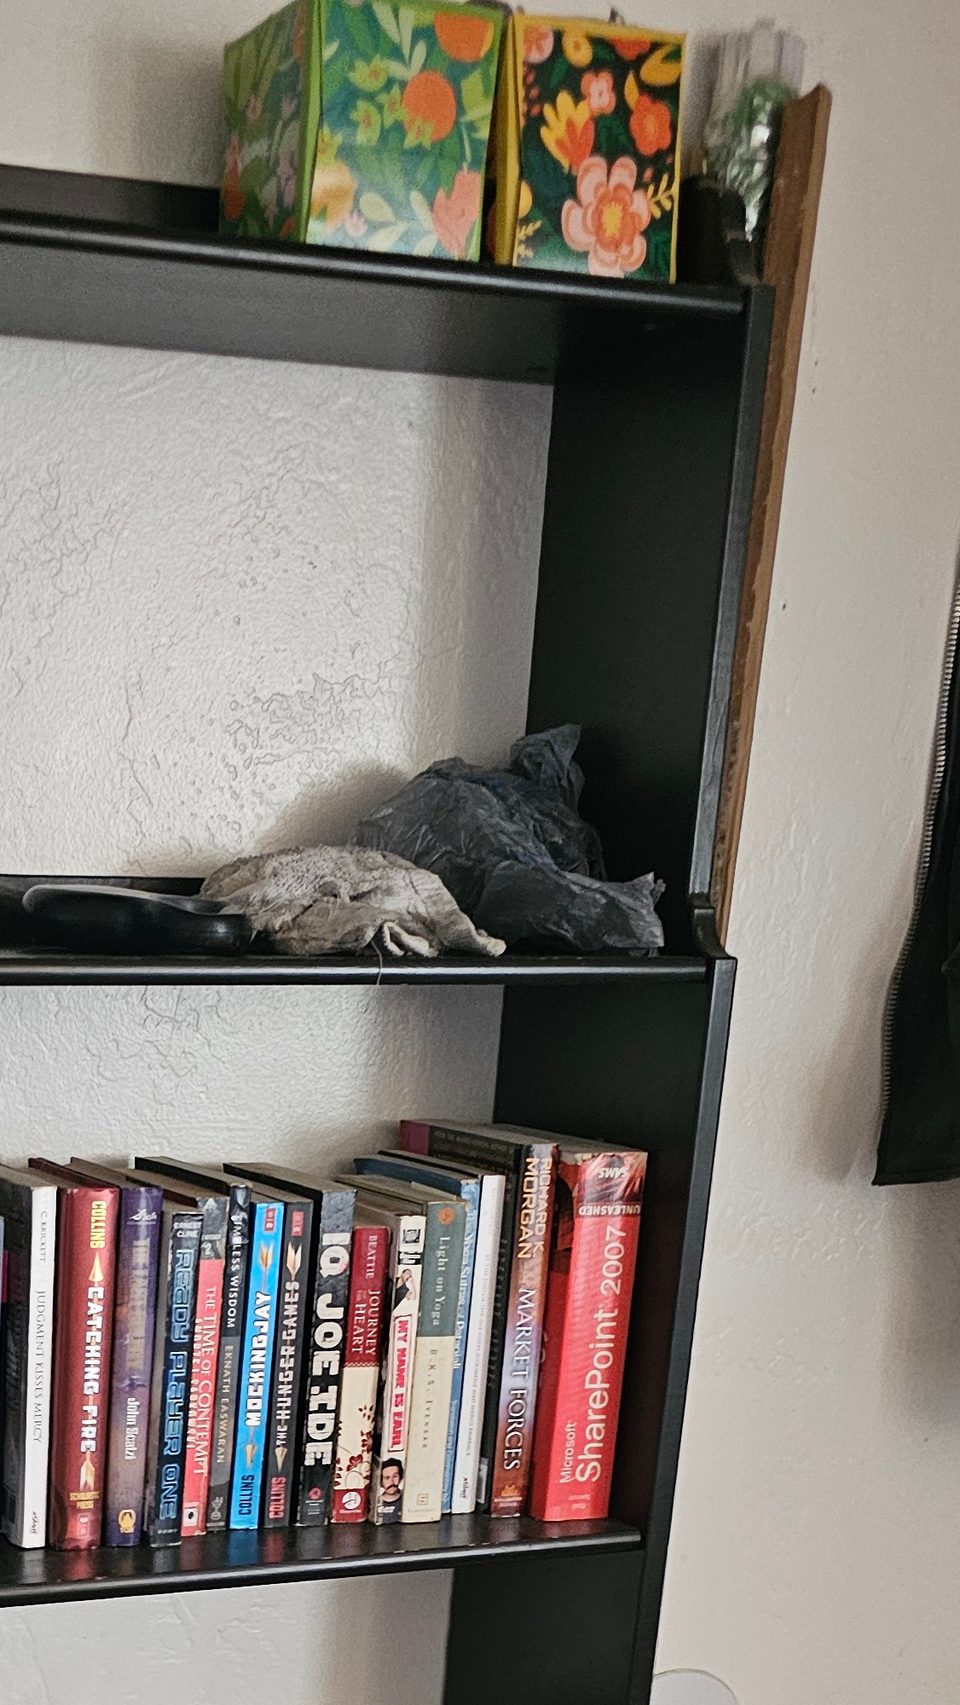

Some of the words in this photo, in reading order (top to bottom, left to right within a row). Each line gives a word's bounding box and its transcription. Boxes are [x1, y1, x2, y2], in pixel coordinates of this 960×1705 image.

[534, 1156, 553, 1237] RICHARD
[598, 1167, 630, 1179] SAMS
[89, 1199, 107, 1250] COLLINS
[516, 1157, 540, 1259] MORGAN
[578, 1203, 641, 1216] UNLEASHED
[319, 1231, 351, 1278] IQ
[365, 1234, 378, 1279] BEATTIE
[436, 1236, 449, 1272] Light
[205, 1285, 217, 1310] THE
[226, 1274, 241, 1329] WISDOM
[435, 1276, 444, 1293] on
[35, 1290, 47, 1358] JUDGMENT
[201, 1311, 218, 1356] TIME
[281, 1280, 300, 1341] GAMES
[311, 1292, 345, 1377] JOE
[351, 1303, 367, 1355] HEART
[365, 1288, 381, 1356] JOURNEY
[397, 1319, 409, 1343] MY
[431, 1296, 444, 1326] Yoga
[510, 1287, 537, 1380] MARKET
[83, 1285, 105, 1396] CATCHING
[245, 1291, 273, 1427] MOCKINGJAY
[574, 1306, 619, 1483] SharePoint
[600, 1225, 627, 1297] 2007
[33, 1362, 44, 1399] KISSES
[201, 1359, 213, 1376] OF
[221, 1344, 234, 1394] EKNATH
[276, 1344, 296, 1421] HUNGER
[395, 1347, 408, 1389] NAME
[32, 1402, 43, 1444] MERCY
[125, 1397, 141, 1425] John
[394, 1393, 404, 1408] IS
[81, 1404, 100, 1453] FIRE
[193, 1379, 213, 1477] CONTEMPT
[216, 1397, 230, 1464] EASWARAN
[275, 1423, 288, 1448] THE
[304, 1385, 338, 1468] IDE
[391, 1411, 403, 1448] EARL
[503, 1388, 528, 1471] FORCES
[558, 1421, 577, 1485] Microsoft
[158, 1463, 180, 1521] ONE
[238, 1473, 256, 1517] COLLINS
[268, 1475, 287, 1520] COLLINS
